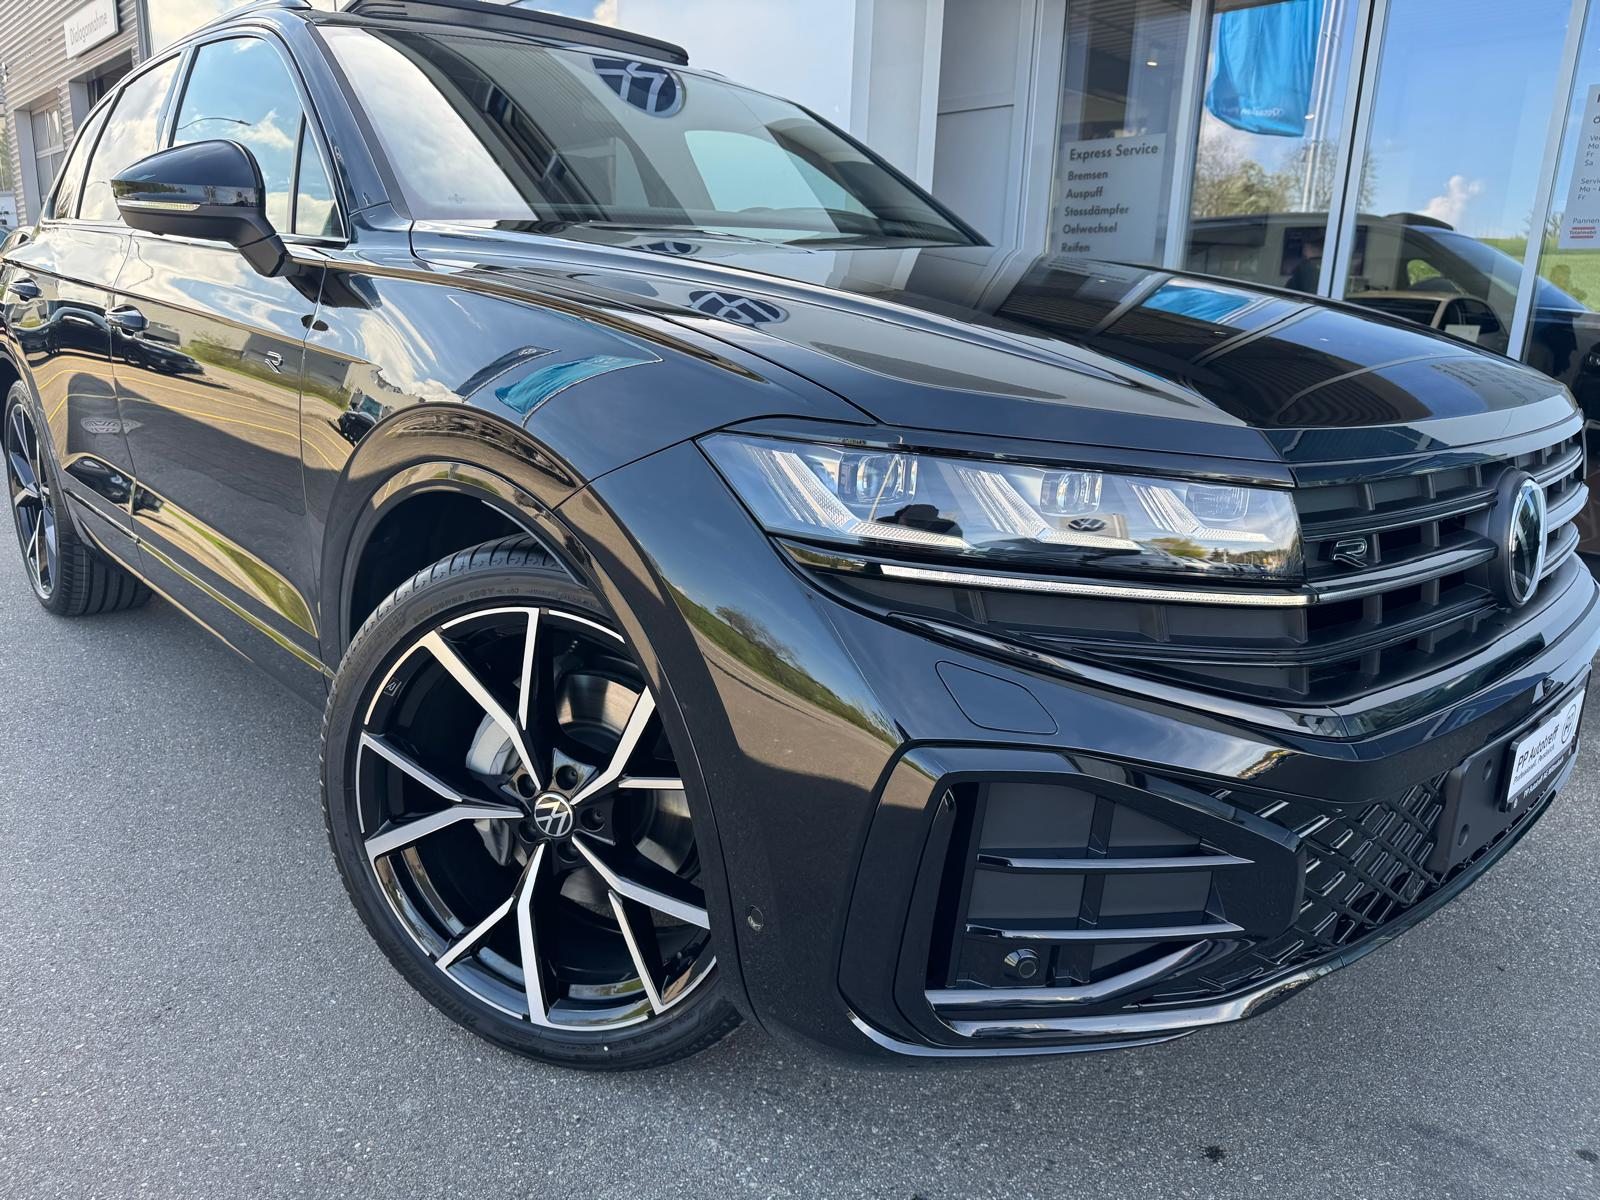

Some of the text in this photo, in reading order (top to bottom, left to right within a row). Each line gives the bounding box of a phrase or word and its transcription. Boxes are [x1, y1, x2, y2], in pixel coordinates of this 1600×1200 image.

[1069, 143, 1159, 162] Express Service
[1067, 170, 1108, 181] Bremsen
[1065, 186, 1104, 200] Auspuff
[1064, 203, 1129, 217] Stossdämpfer
[1062, 222, 1118, 234] Oelwechsel
[1060, 241, 1091, 253] Reifen
